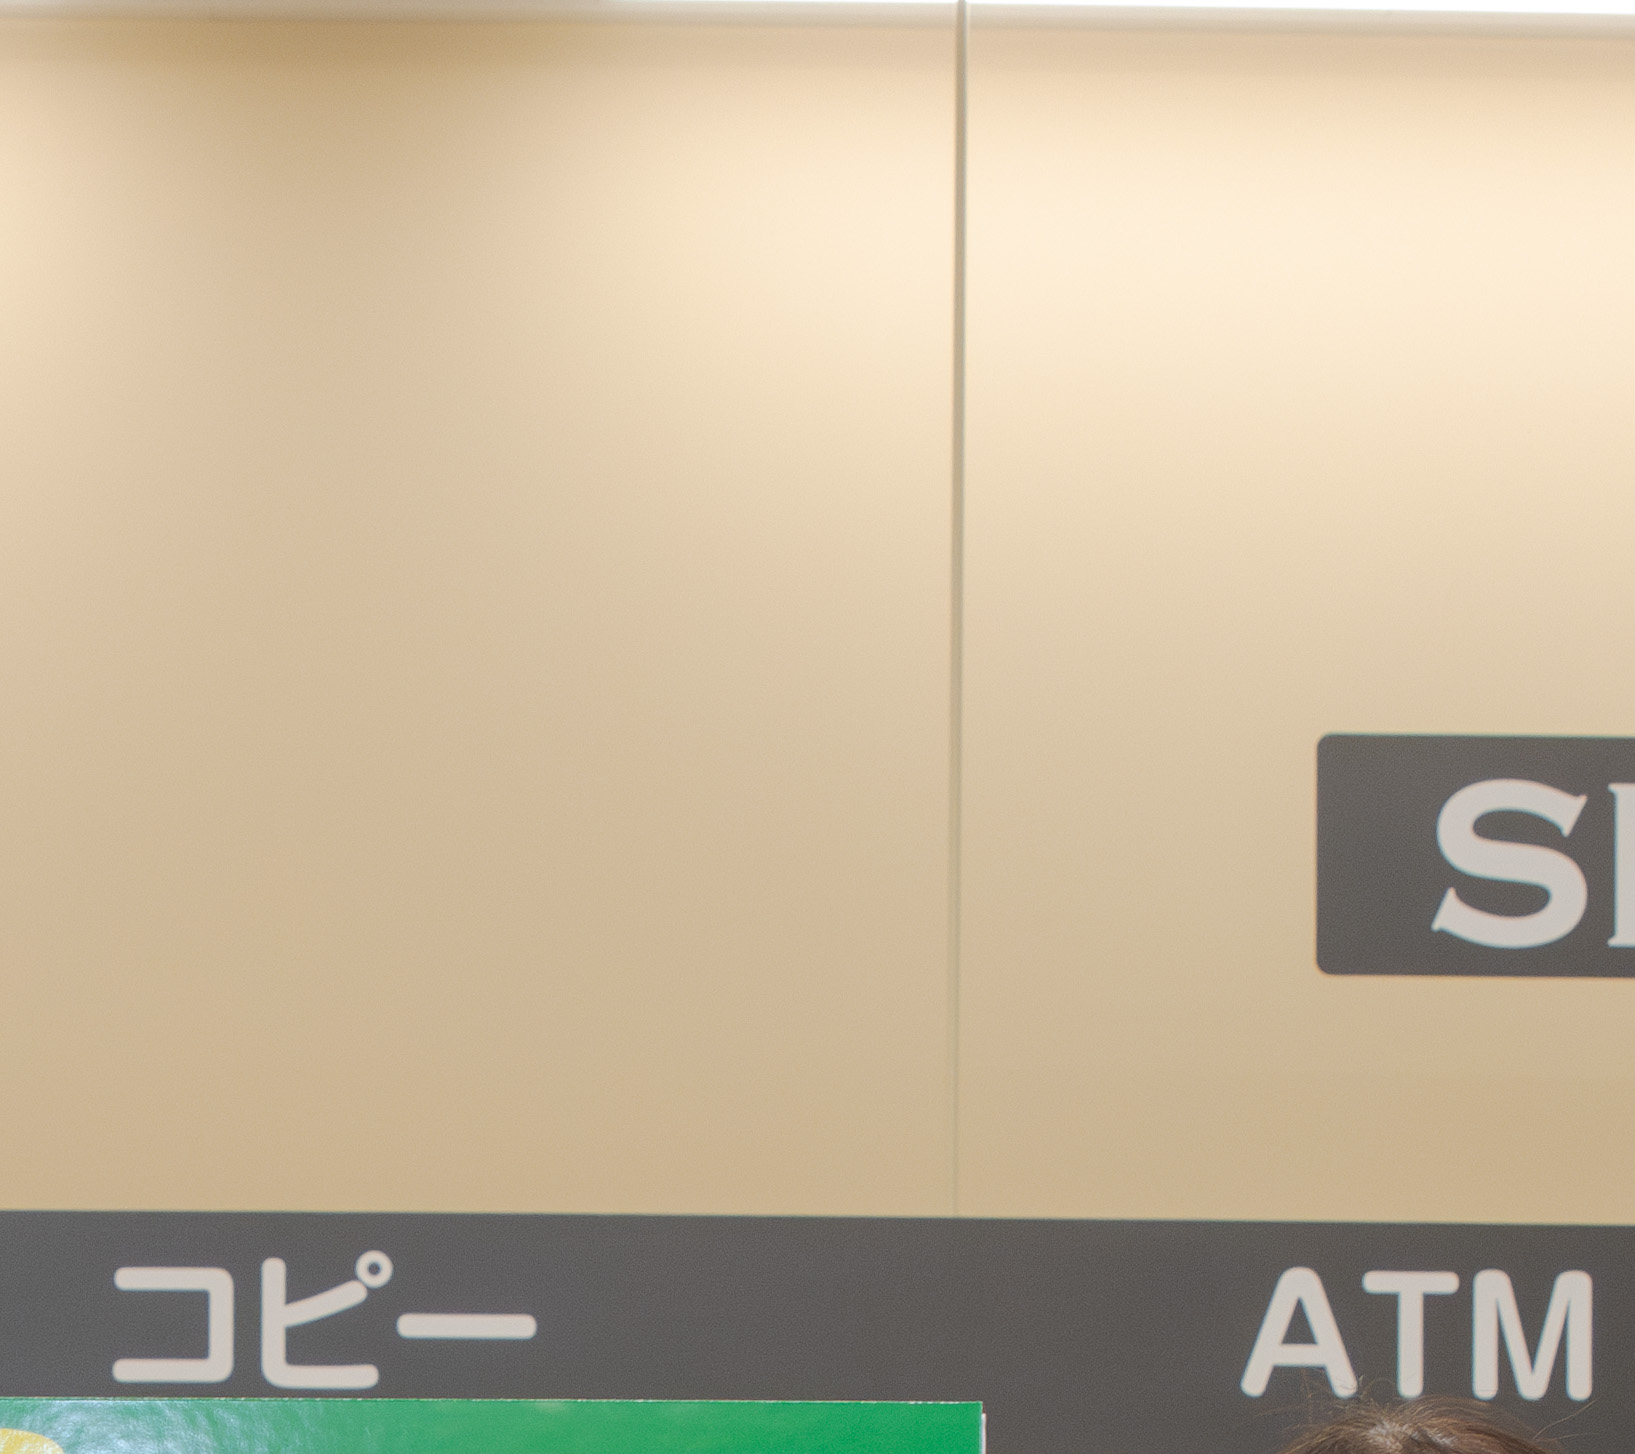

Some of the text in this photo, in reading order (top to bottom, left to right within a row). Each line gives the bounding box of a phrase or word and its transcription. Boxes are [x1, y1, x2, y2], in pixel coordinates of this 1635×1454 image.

[112, 1250, 538, 1390] コピー
[1241, 1265, 1594, 1401] ATM
